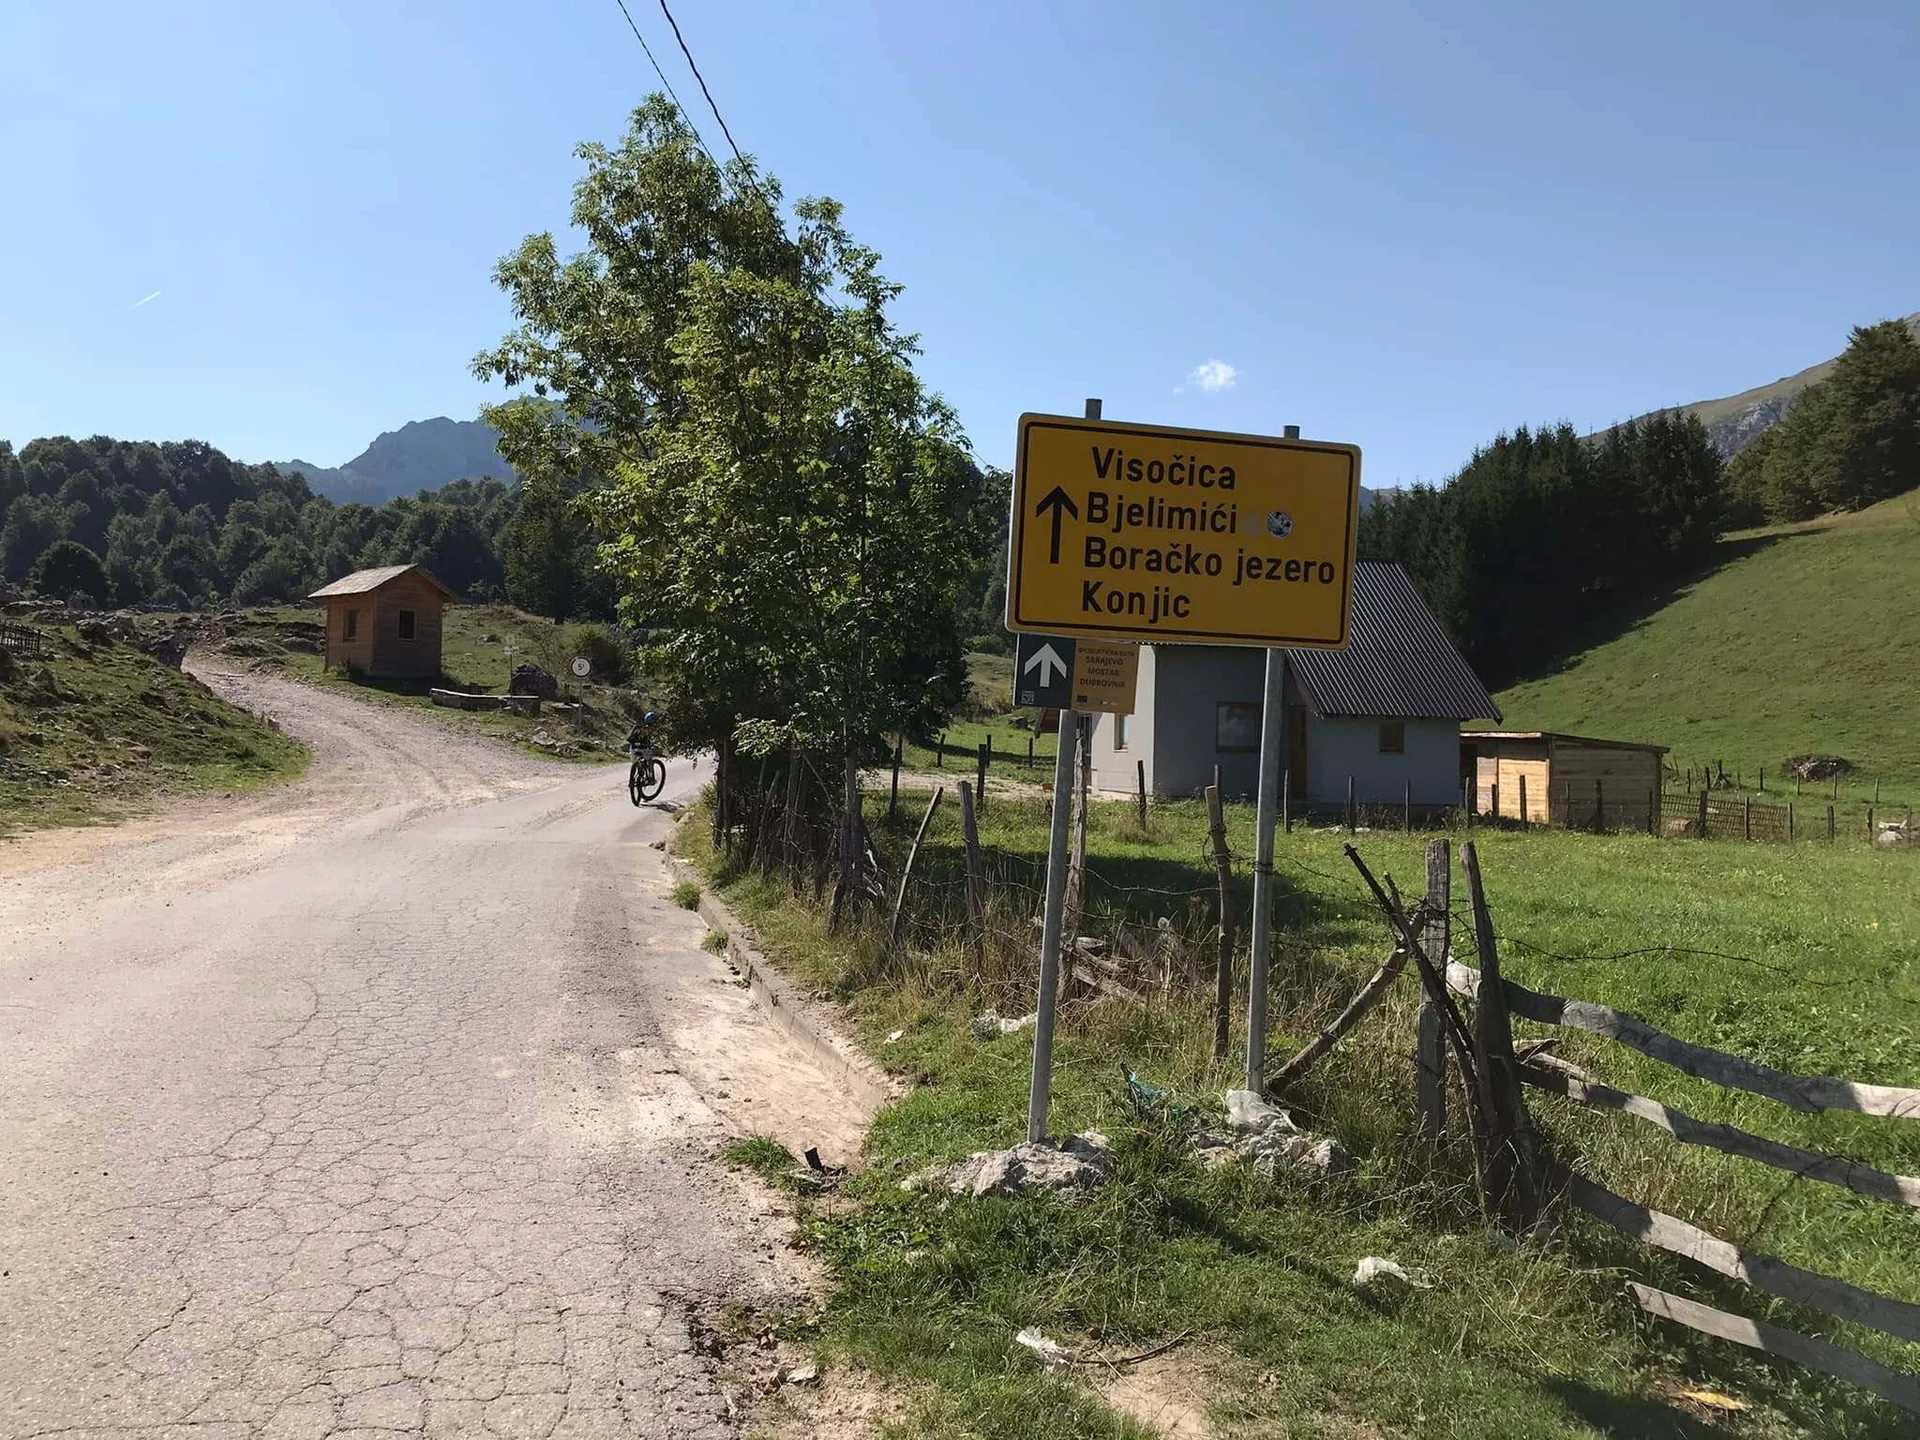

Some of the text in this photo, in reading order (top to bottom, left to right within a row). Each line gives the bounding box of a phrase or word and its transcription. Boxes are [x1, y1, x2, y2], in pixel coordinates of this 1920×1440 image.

[1091, 446, 1237, 490] Visočica
[1086, 491, 1238, 534] Bjelimići
[1084, 536, 1336, 586] Boračko jezero
[1081, 580, 1191, 624] Konjic
[1085, 656, 1124, 666] SARAJEVO
[1088, 668, 1119, 676] MOSTAR
[1080, 678, 1125, 688] DUBROVNIK
